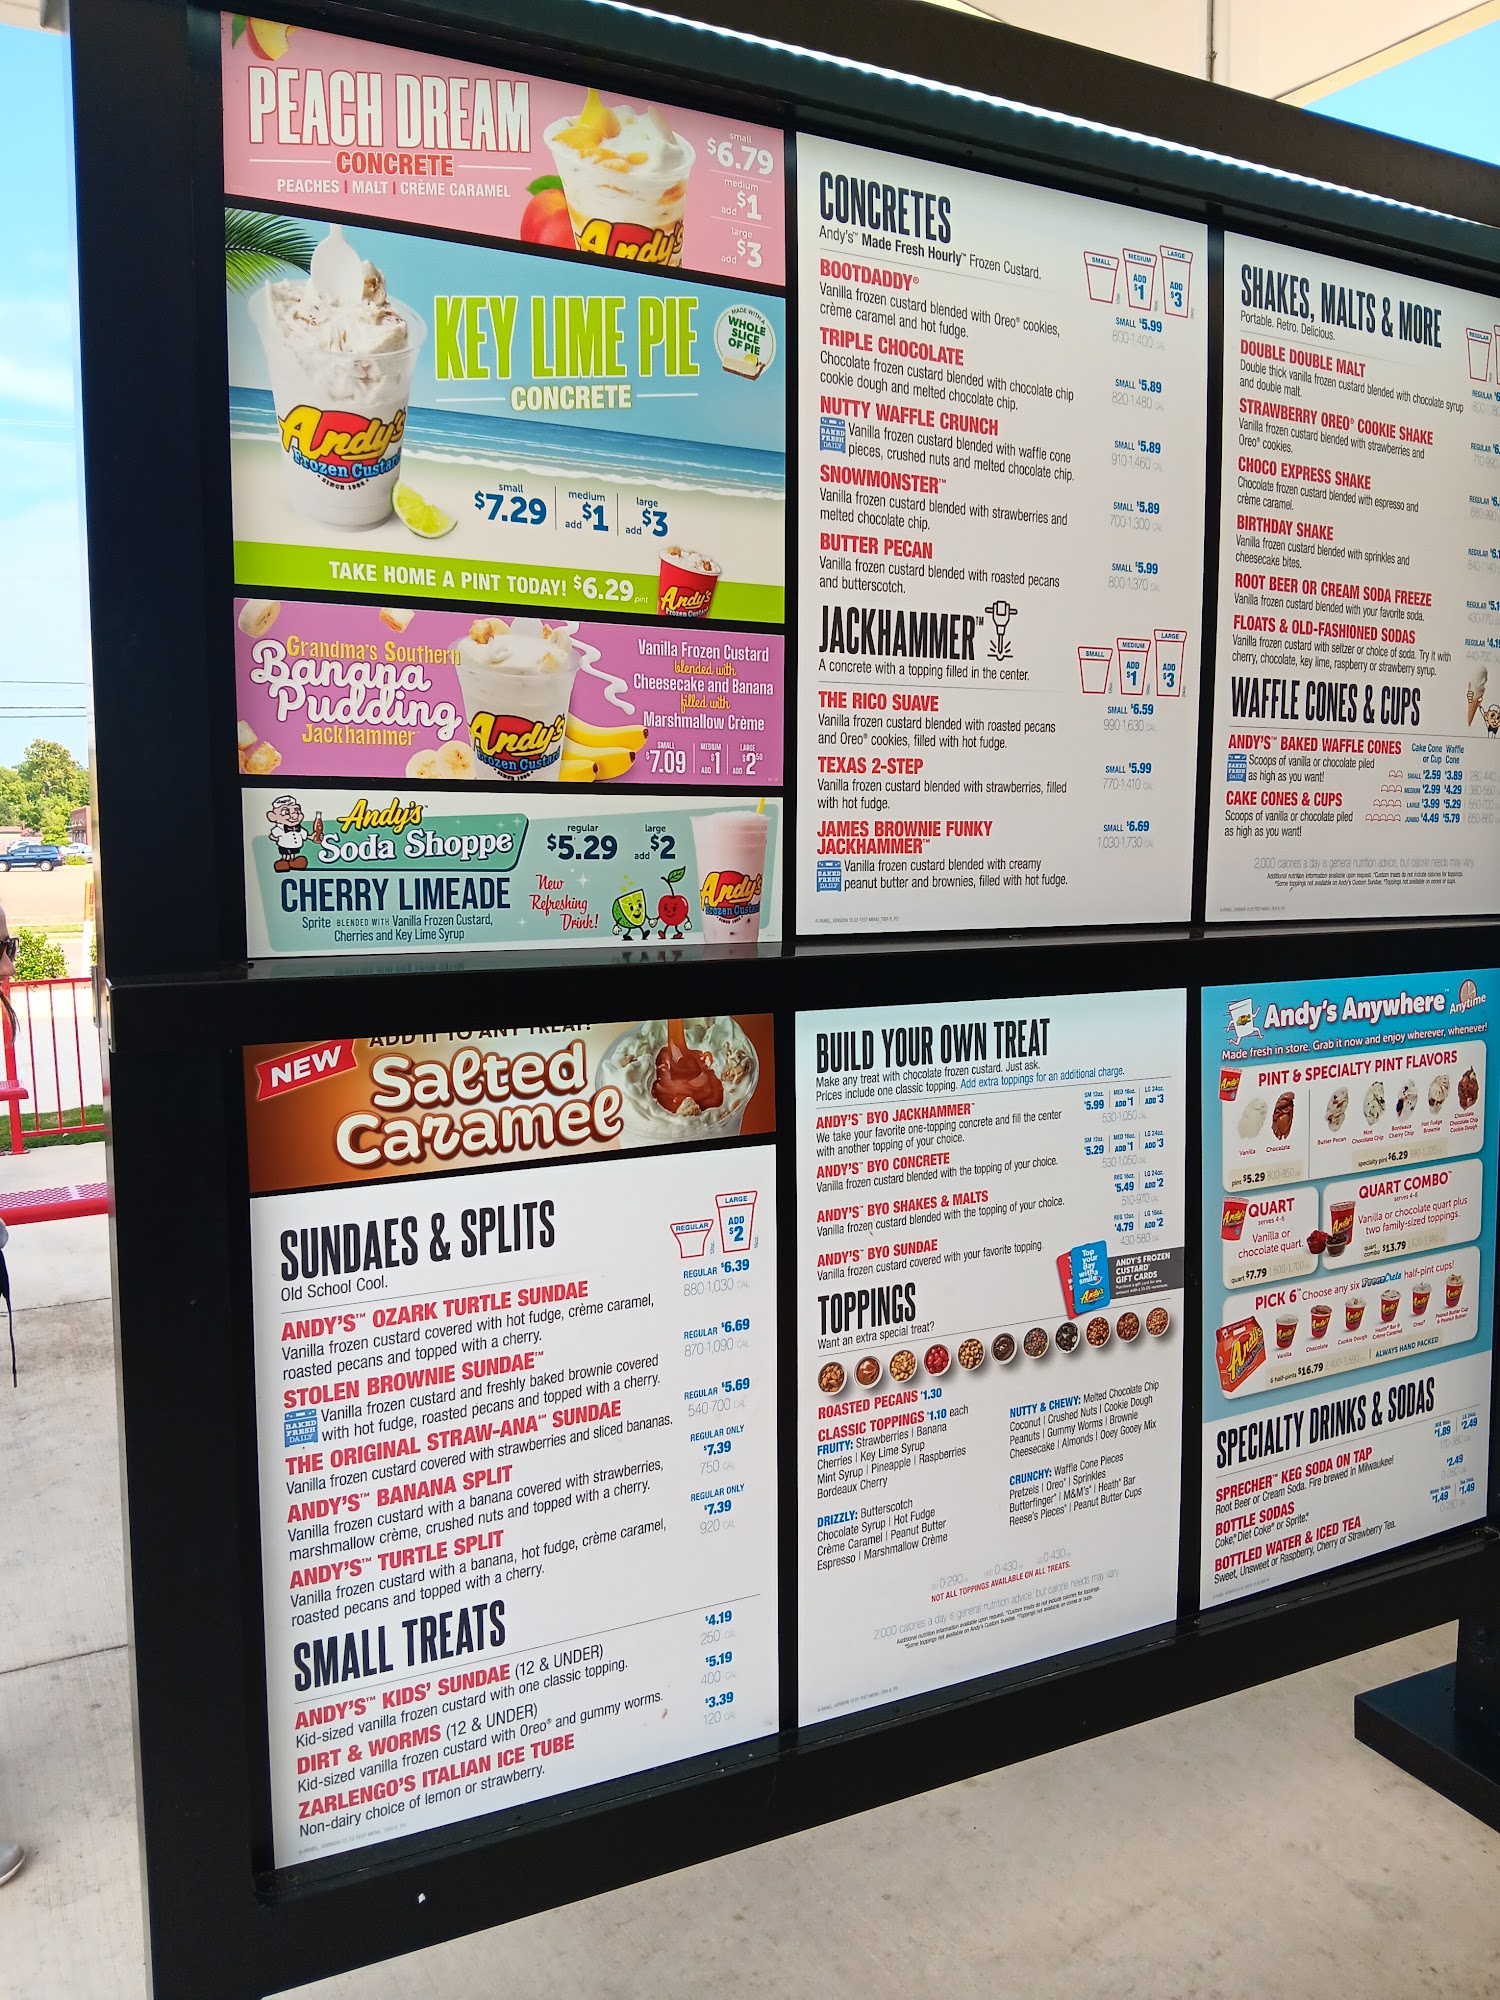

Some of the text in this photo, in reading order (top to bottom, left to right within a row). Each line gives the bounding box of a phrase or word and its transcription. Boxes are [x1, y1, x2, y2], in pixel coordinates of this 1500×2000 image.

[247, 65, 534, 153] PEACH DREAM
[729, 132, 752, 143] small
[336, 151, 453, 176] CONCRETE
[706, 137, 774, 174] $6.79
[277, 178, 510, 198] PEACHES MALT CRÈME CARAMEL
[724, 178, 759, 191] medium
[819, 170, 950, 243] CONCRETES
[731, 227, 752, 239] large
[1241, 263, 1441, 348] SHAKES, MALTS & MORE
[434, 295, 699, 380] KEY LIME PIE
[819, 326, 963, 366] TRIPLE CHOCOLATE
[509, 383, 632, 411] CONCRETE
[1238, 456, 1370, 489] CHOCO EXPRESS SHAKE
[498, 483, 523, 493] small
[568, 491, 605, 501] medium
[474, 491, 546, 524] $7.29
[636, 497, 658, 508] large
[1237, 514, 1333, 540] BIRTHDAY SHAKE
[820, 532, 932, 559] BUTTER PECAN
[328, 560, 633, 601] TAKE HOME A PINT TODAY! $6.29
[286, 634, 461, 666] Grandma's Southern
[637, 638, 769, 662] Vanilla Frozen Custard
[252, 640, 431, 693] Banana
[818, 658, 1029, 680] A concrete with a topping filled in the center.
[632, 672, 774, 696] Cheesecake and Banana
[269, 680, 463, 740] Pudding
[1107, 703, 1153, 714] SMALL $6.59
[1231, 676, 1420, 726] WAFFLE CONES & CUPS
[643, 711, 765, 731] Marshmallow Crème
[644, 747, 686, 774] $7.09
[1248, 753, 1374, 770] Scoops of vanilla or chocolate piled
[338, 798, 424, 832] Andy's
[567, 823, 598, 833] regular
[644, 824, 665, 834] large
[318, 827, 514, 863] Soda Shoppe
[546, 833, 617, 859] $5.29
[280, 877, 510, 912] CHERRY LIMEADE
[535, 874, 563, 890] New
[528, 894, 587, 914] Refreshing
[334, 927, 464, 942] Cherries and Key Lime Syrup
[560, 913, 598, 930] Drink!
[1264, 989, 1446, 1030] Andy's Anywhere
[1450, 992, 1487, 1015] Anytime
[816, 1017, 1050, 1073] BUILD YOUR OWN TREAT
[269, 1046, 341, 1088] NEW
[373, 1042, 587, 1107] Salted
[1258, 1049, 1457, 1086] PINT & SPECIALTY PINT FLAVORS
[336, 1087, 623, 1166] Caramel
[1358, 1179, 1401, 1198] QUART
[1248, 1197, 1294, 1217] QUART
[280, 1199, 554, 1281] SUNDAES & SPLITS
[1237, 1239, 1303, 1258] chocolate quart.
[1252, 1229, 1290, 1243] Vanilla or
[281, 1274, 387, 1301] Old School Cool.
[817, 1282, 915, 1335] TOPPINGS
[817, 1321, 934, 1349] Want an extra special treat?
[1375, 1336, 1438, 1357] ALWAYS HAND PACKED
[1216, 1376, 1434, 1468] SPECIALTY DRINKS & SODAS
[817, 1498, 912, 1527] DRIZZLY: Butterscotch
[1215, 1501, 1294, 1536] BOTTLE SODAS
[931, 1560, 1070, 1602] NOT ALL TOPPINGS AVAILABLE ON ALL TREATS.
[293, 1599, 505, 1691] SMALL TREATS
[298, 1732, 574, 1819] ZARLENGO'S ITALIAN ICE TUBE
[299, 1764, 544, 1837] Non-dairy choice of lemon or strawberry.
